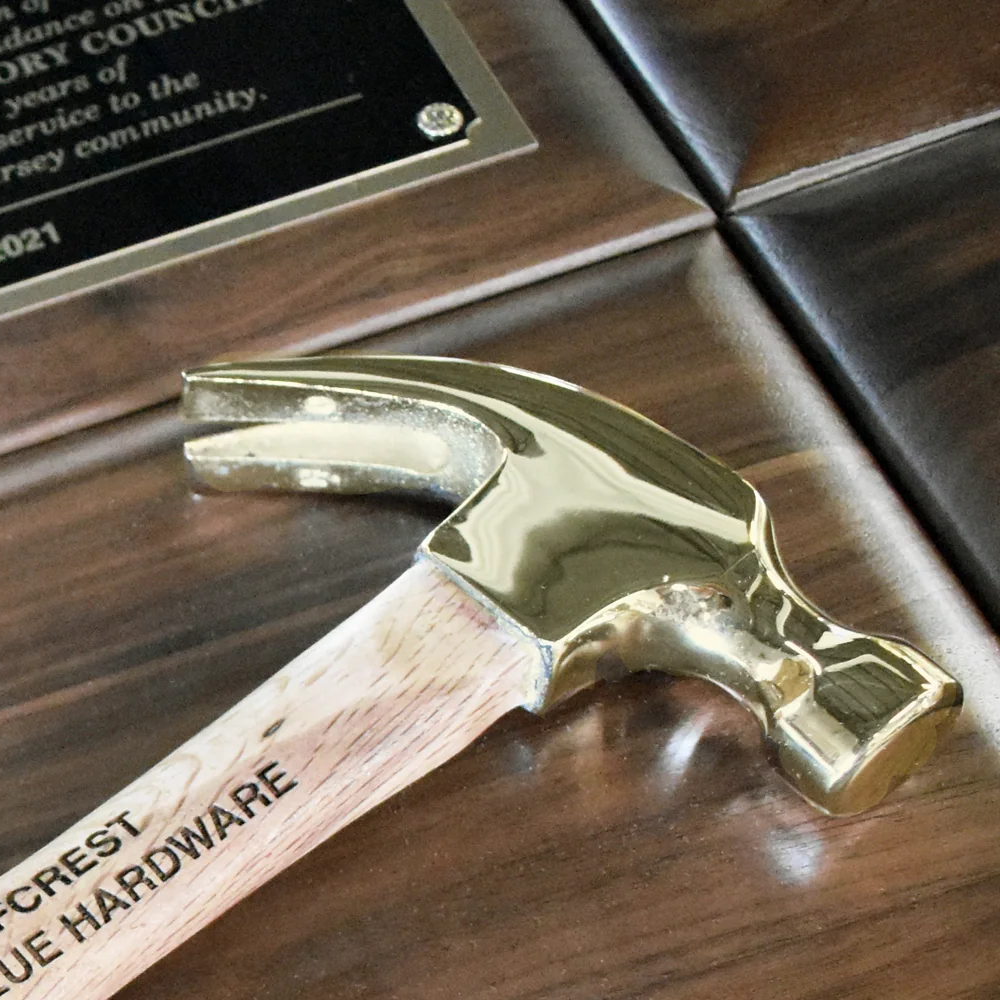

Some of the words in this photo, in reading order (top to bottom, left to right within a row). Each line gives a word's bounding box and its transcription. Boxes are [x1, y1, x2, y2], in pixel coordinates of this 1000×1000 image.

[4, 75, 91, 119] years
[97, 53, 127, 84] of
[109, 92, 141, 114] to
[148, 72, 200, 100] the
[74, 87, 269, 159] community.
[59, 760, 299, 944] HARDWARE
